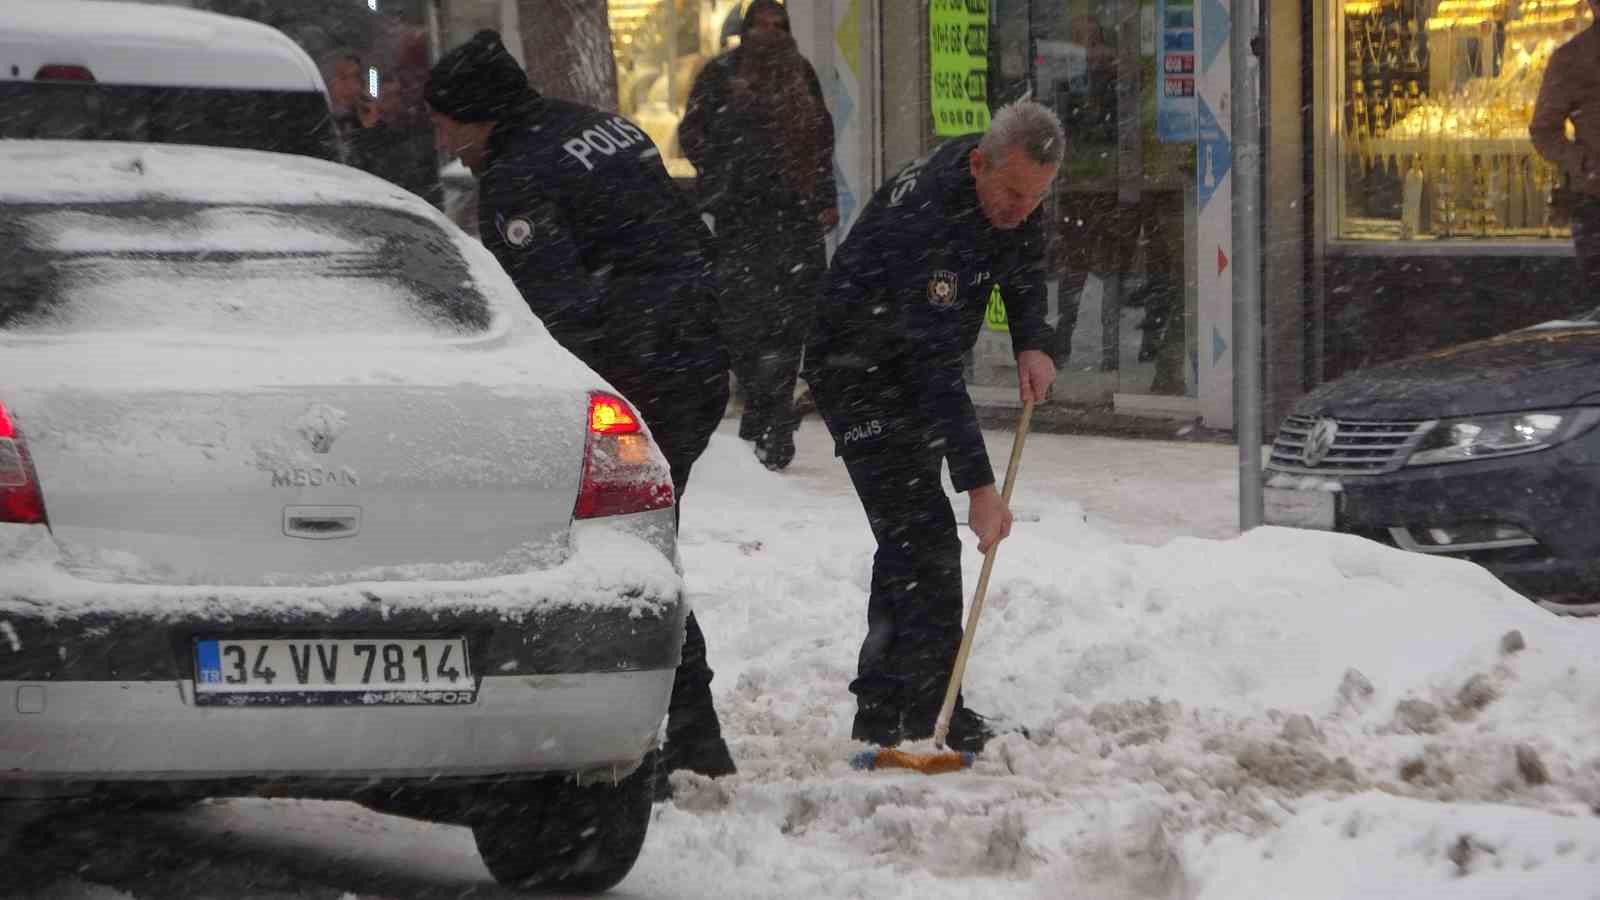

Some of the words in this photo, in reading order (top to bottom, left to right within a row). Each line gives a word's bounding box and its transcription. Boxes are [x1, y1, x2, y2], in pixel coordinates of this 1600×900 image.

[223, 644, 276, 685] 34
[288, 644, 338, 685] VV
[353, 644, 459, 684] 7814
